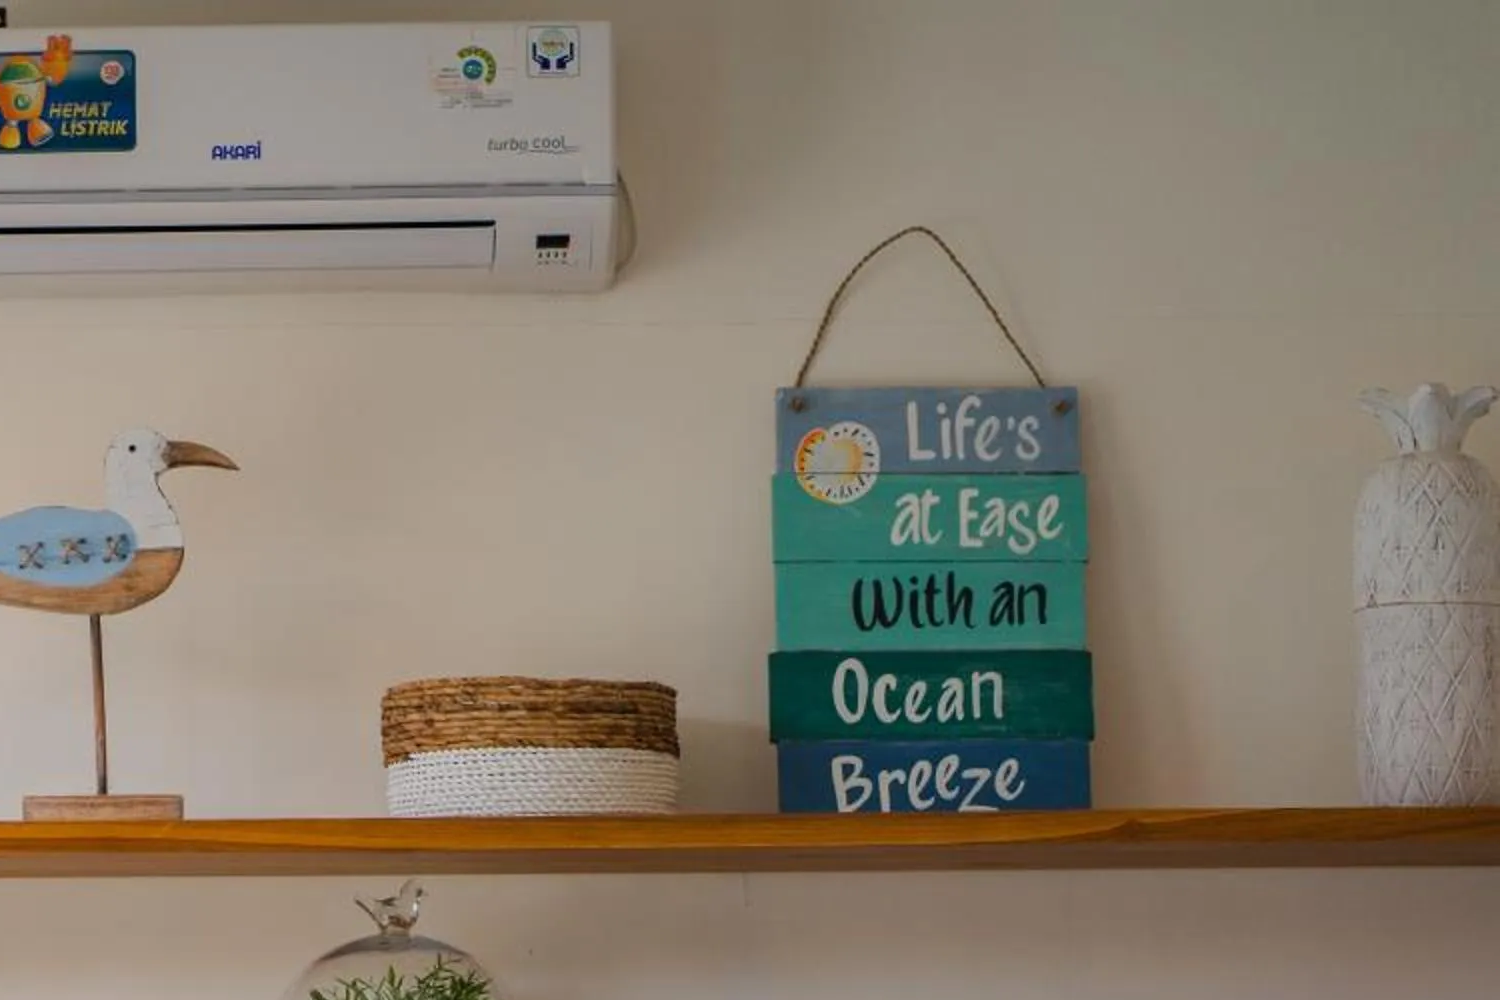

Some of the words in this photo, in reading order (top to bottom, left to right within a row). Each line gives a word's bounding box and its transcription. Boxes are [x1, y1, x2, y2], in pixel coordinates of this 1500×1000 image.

[49, 101, 112, 119] HEMAT
[60, 119, 128, 136] LISTRIK
[488, 138, 528, 151] turbo
[532, 136, 566, 149] cool
[906, 395, 1041, 462] Life's
[890, 489, 942, 546] at
[958, 488, 1064, 555] Ease
[851, 571, 977, 632] With
[989, 579, 1048, 627] an
[832, 657, 1005, 725] Ocean
[830, 754, 1026, 813] Breeze
